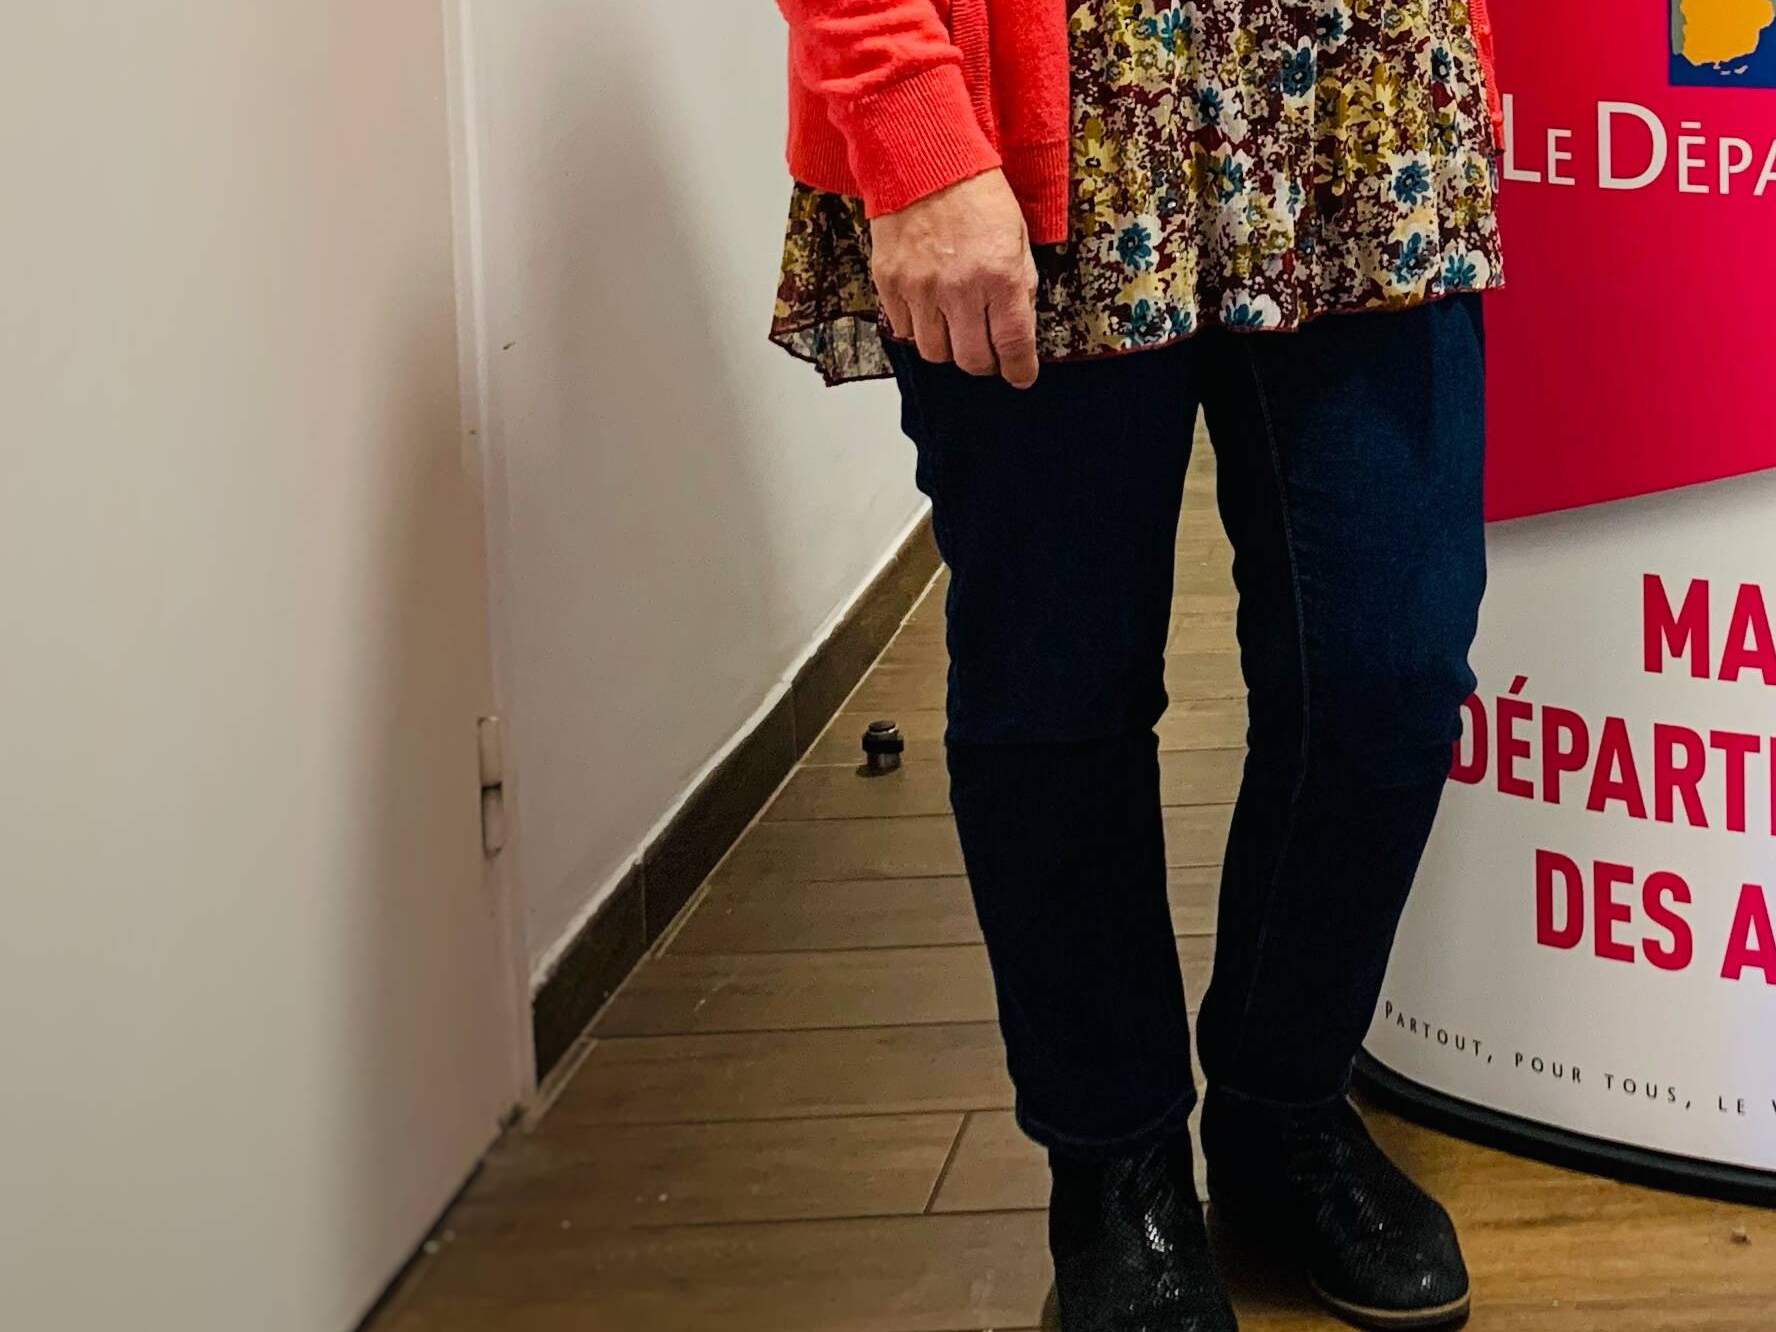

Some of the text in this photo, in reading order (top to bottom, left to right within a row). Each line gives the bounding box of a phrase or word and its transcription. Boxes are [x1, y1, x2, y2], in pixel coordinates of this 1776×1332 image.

[1535, 850, 1694, 973] DES
[1384, 1000, 1494, 1064] PARTOUT,
[1514, 1051, 1582, 1084] POUR
[1604, 1073, 1693, 1110] TOUS,
[1717, 1096, 1748, 1114] LE
